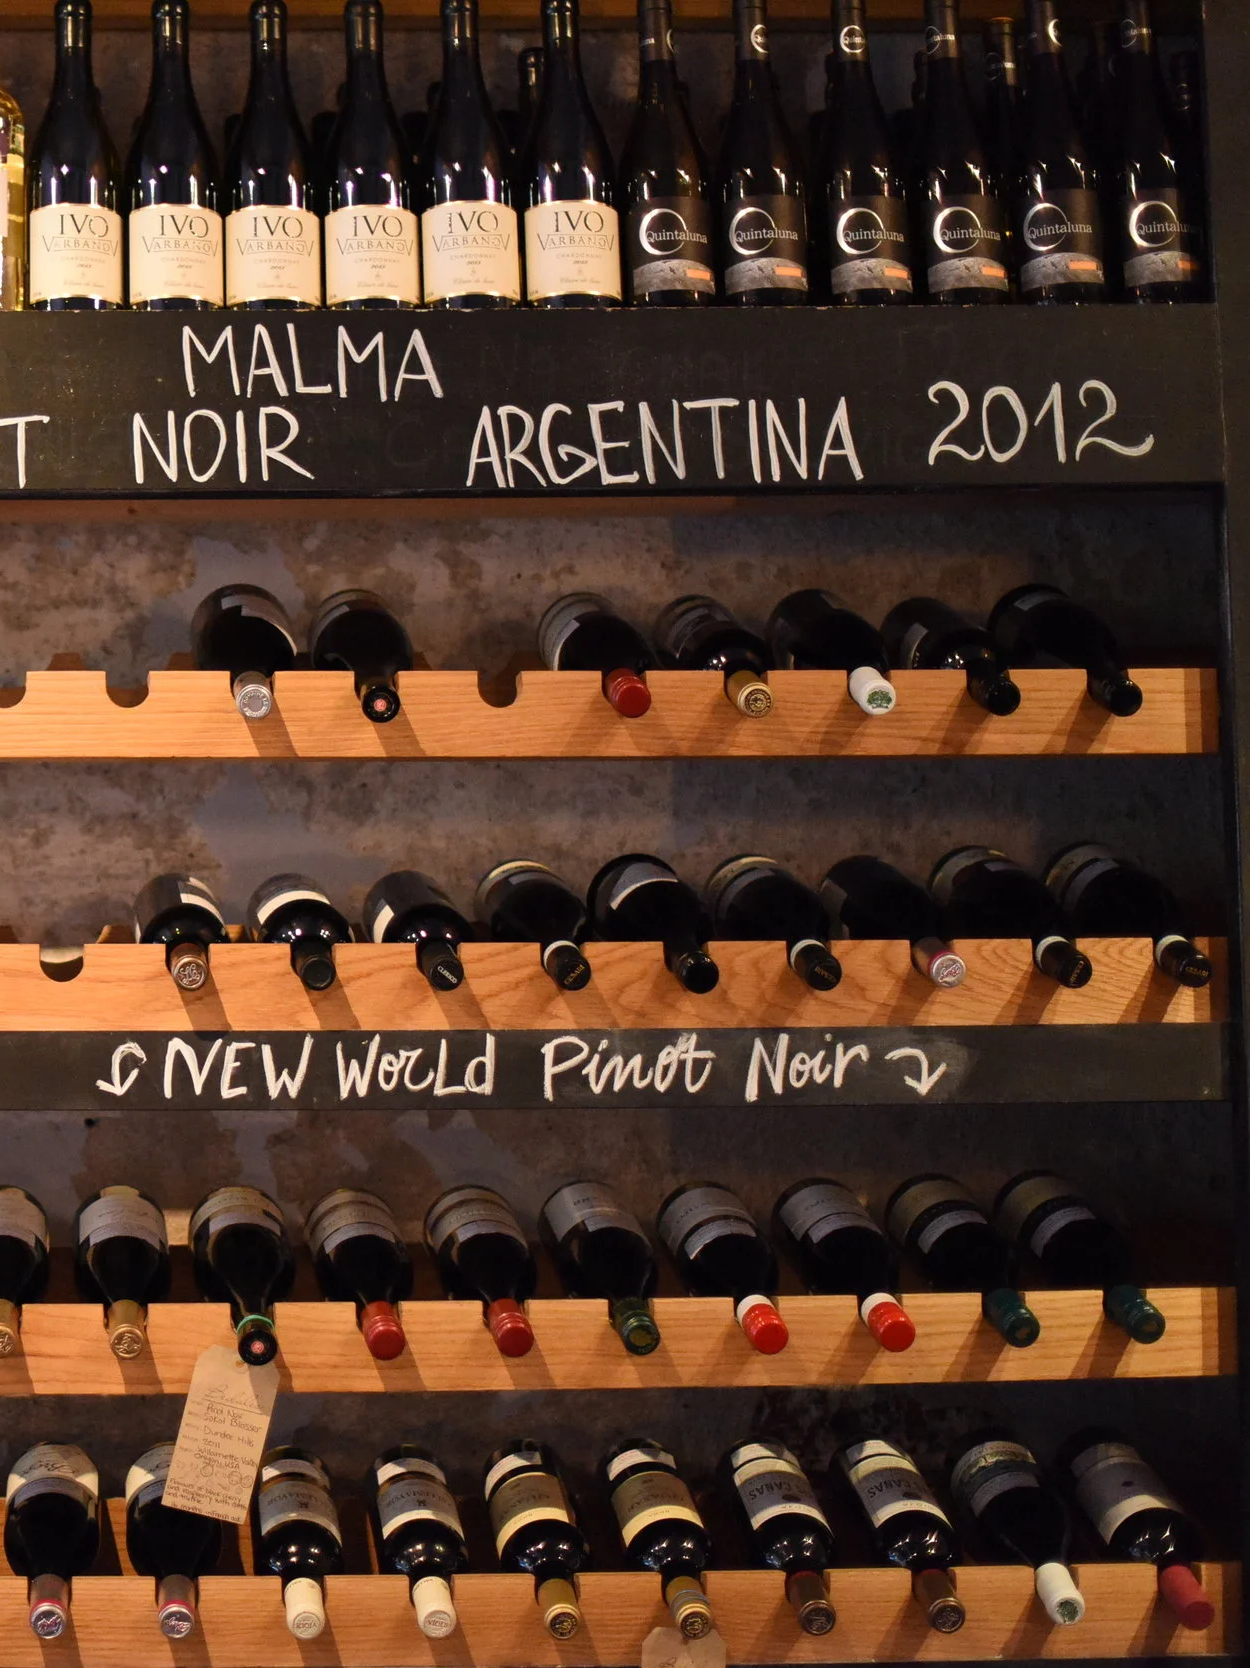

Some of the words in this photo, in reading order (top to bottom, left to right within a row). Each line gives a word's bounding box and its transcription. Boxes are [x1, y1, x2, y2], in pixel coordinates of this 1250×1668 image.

[60, 214, 109, 238] IVO
[159, 214, 209, 238] IVO
[253, 216, 303, 239] IVO
[353, 216, 403, 238] IVO
[448, 210, 499, 234] IVO
[554, 210, 604, 233] IVO
[1028, 221, 1092, 239] Quintaluna
[432, 234, 510, 252] VARBANOV
[537, 232, 615, 251] VARBANOV
[646, 229, 707, 244] Quintaluna
[734, 227, 798, 243] Quintaluna
[843, 228, 904, 243] Quintaluna
[940, 226, 1001, 241] Quintaluna
[42, 235, 119, 257] VARBANOV
[142, 236, 219, 257] VARBANOV
[236, 238, 315, 257] VARBANOV
[336, 238, 414, 256] VARBANOV
[183, 323, 443, 402] MALMA
[133, 406, 315, 484] NOIR
[467, 397, 864, 487] ARGENTINA
[928, 380, 1155, 465] 2012
[164, 1033, 313, 1099] NEW
[543, 1032, 715, 1099] Pinot
[747, 1034, 869, 1101] Noir
[203, 1413, 226, 1424] Sokol
[230, 1418, 262, 1433] Blosser
[203, 1425, 233, 1440] Dundee
[198, 1446, 239, 1462] Willamette
